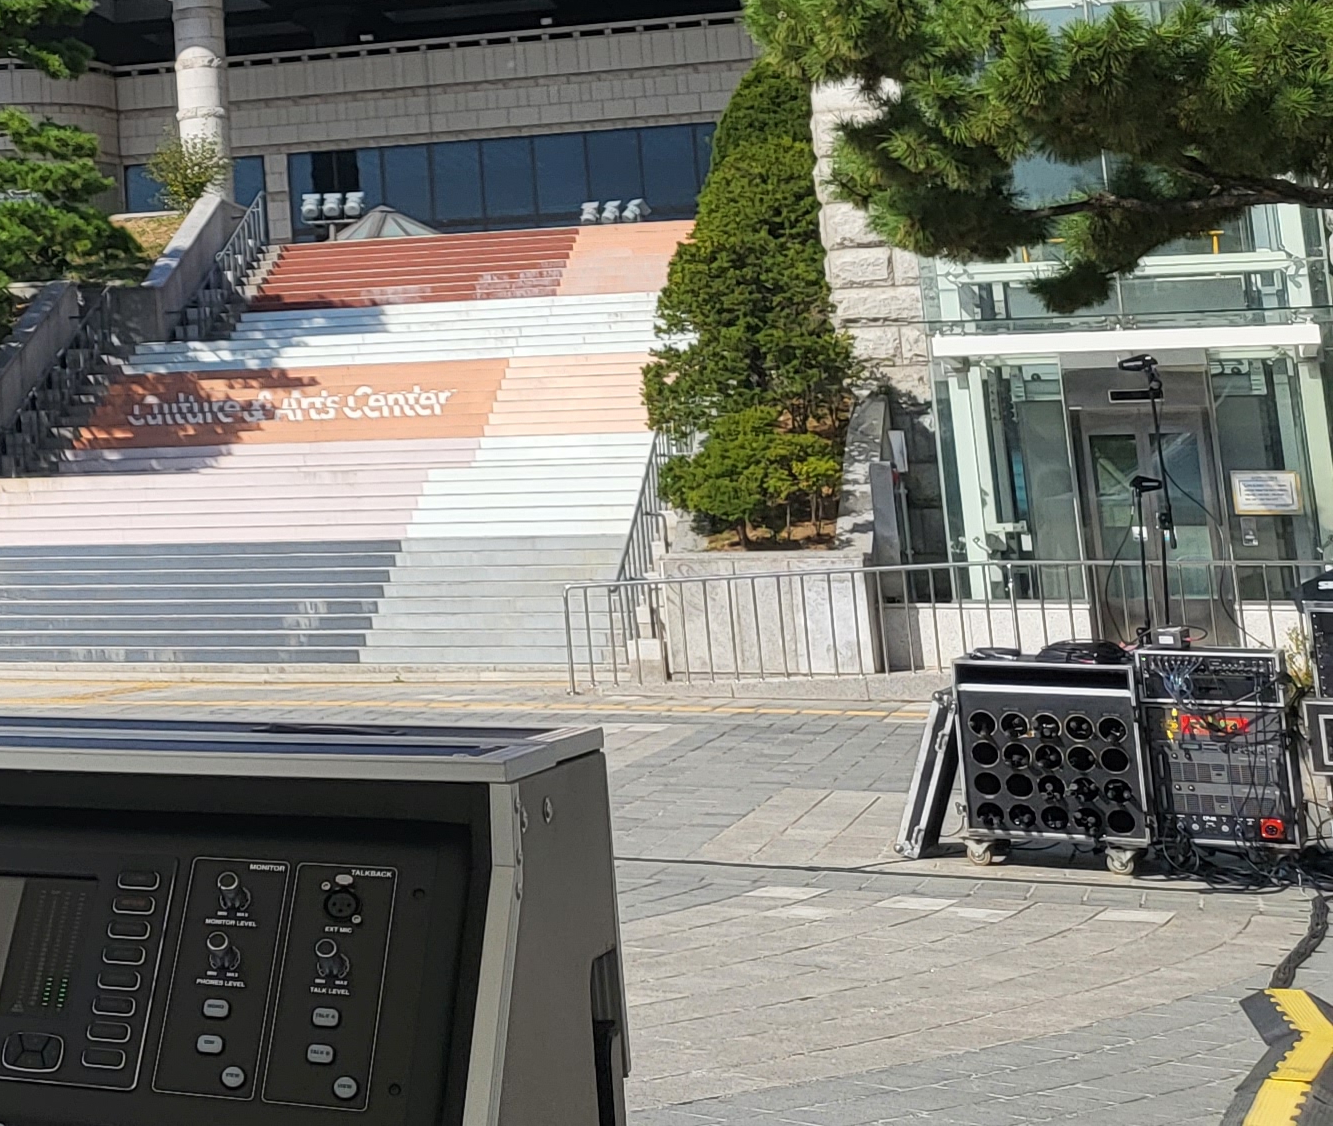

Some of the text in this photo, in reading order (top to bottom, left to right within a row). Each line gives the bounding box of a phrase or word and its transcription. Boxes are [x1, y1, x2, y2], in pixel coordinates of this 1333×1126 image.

[127, 392, 237, 426] Culture
[277, 388, 341, 422] Arts
[343, 384, 455, 419] Center
[249, 863, 285, 872] MONITOR
[351, 869, 392, 878] TALKBACK
[205, 918, 235, 926] MONITOR
[196, 978, 245, 988] PHONES LEVEL
[310, 986, 350, 996] TALK LEVEL
